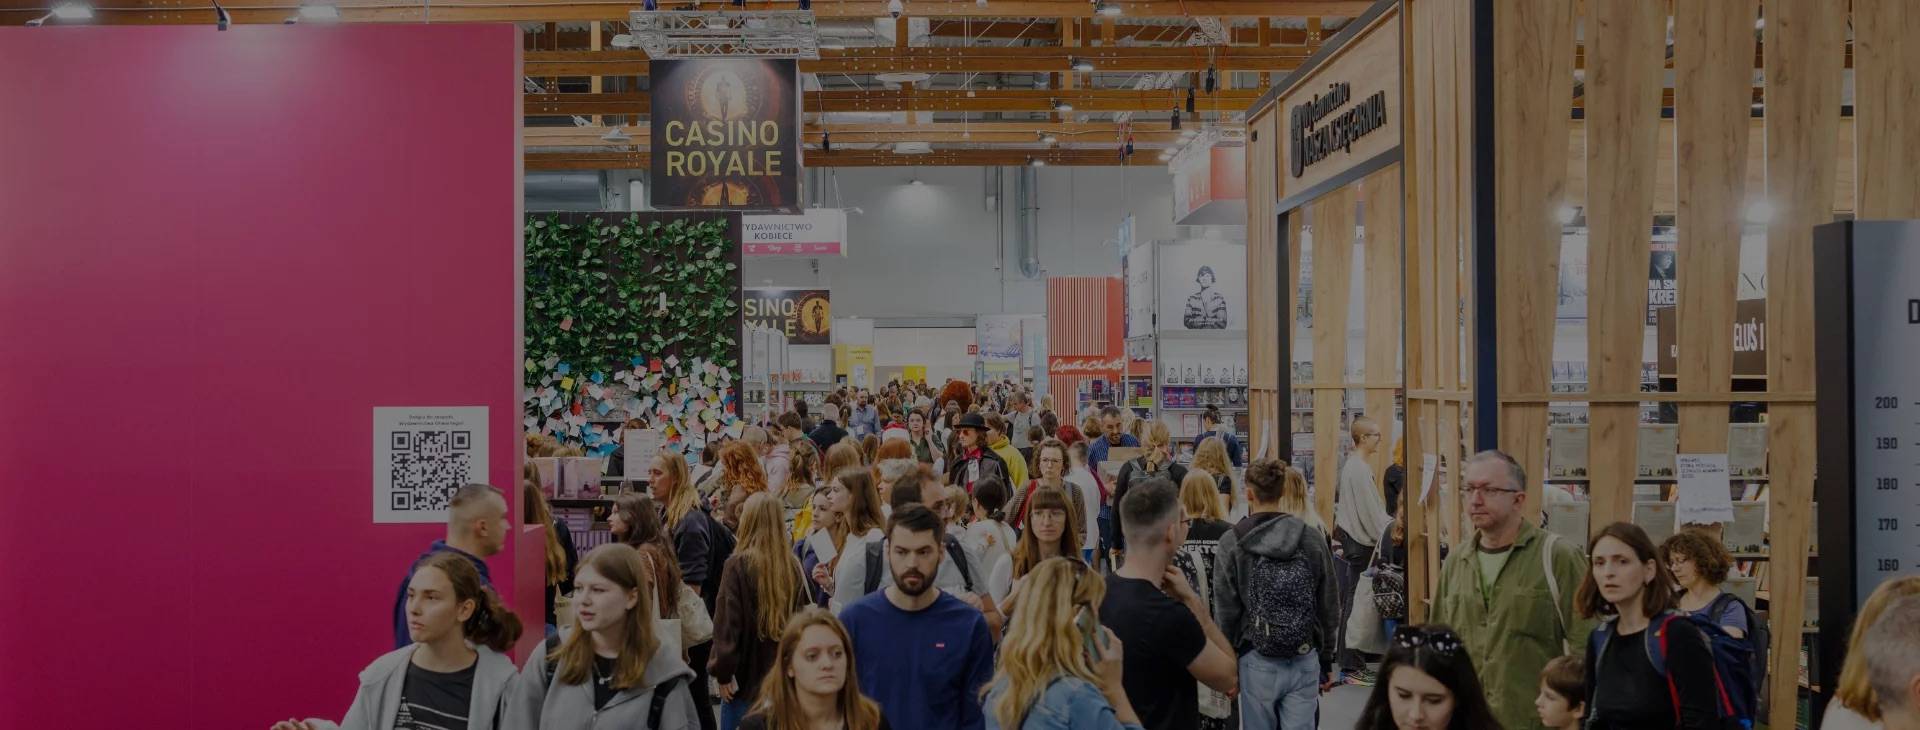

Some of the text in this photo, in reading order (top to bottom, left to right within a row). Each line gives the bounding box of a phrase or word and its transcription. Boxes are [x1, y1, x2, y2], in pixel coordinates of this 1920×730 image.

[665, 120, 779, 146] CASINO
[666, 150, 782, 177] ROYALE
[754, 232, 793, 240] KOBIECE
[1875, 397, 1898, 409] 200
[1876, 437, 1898, 449] 190
[1876, 478, 1898, 490] 180
[1878, 518, 1898, 530] 170
[1877, 559, 1899, 571] 160
